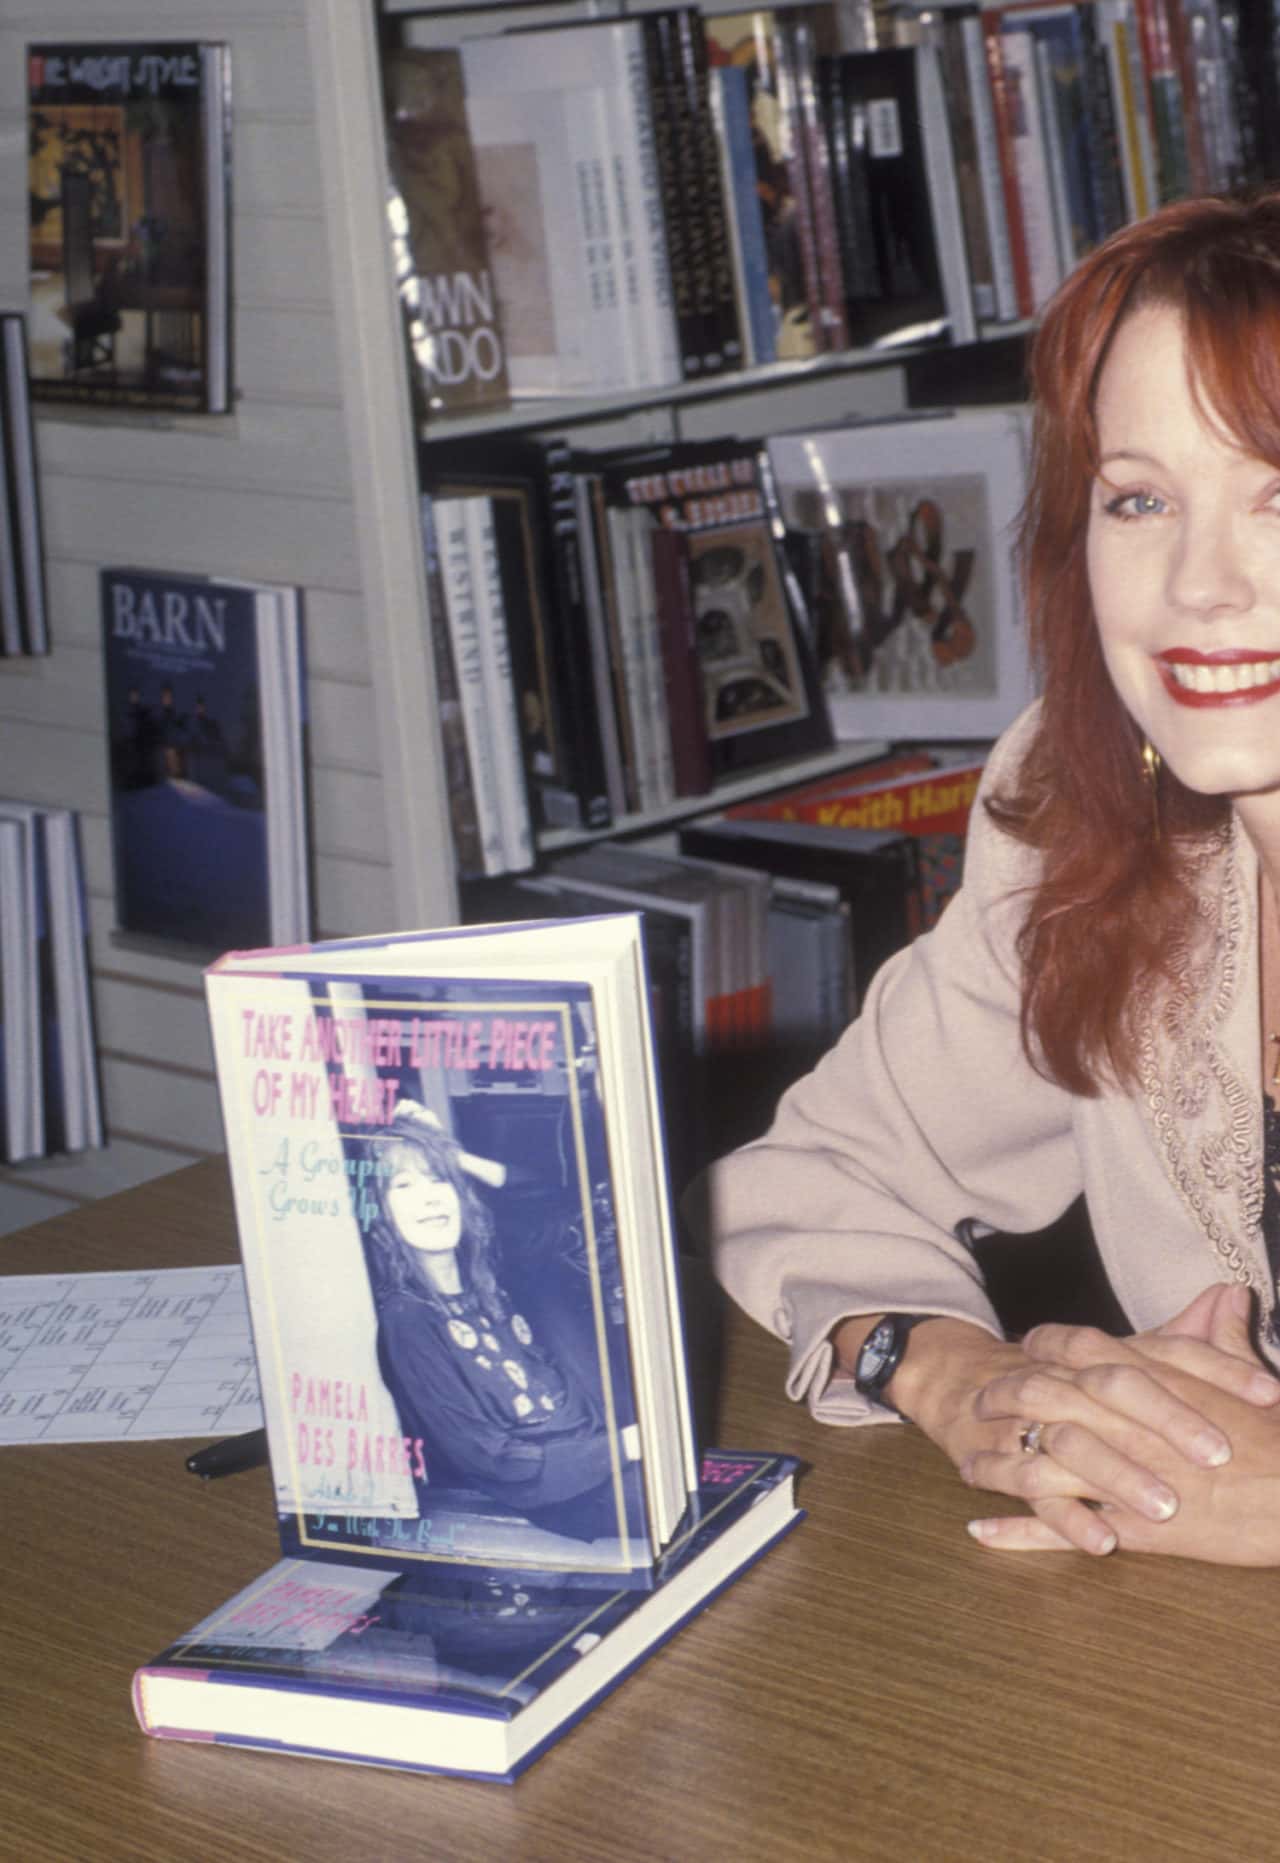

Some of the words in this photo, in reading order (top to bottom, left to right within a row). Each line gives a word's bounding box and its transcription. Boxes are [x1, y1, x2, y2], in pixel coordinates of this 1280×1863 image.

[112, 582, 227, 654] BARN
[816, 791, 905, 830] Keith
[241, 1008, 293, 1061] TAKE
[299, 1014, 402, 1068] ANOTHER
[409, 1016, 482, 1071] LITTLE
[487, 1017, 557, 1071] PIECE
[252, 1068, 283, 1117] OF
[289, 1071, 320, 1121] MY
[327, 1071, 400, 1127] HEART
[290, 1371, 369, 1423] PAMELA
[296, 1421, 336, 1468] DES
[346, 1427, 425, 1478] BARRES
